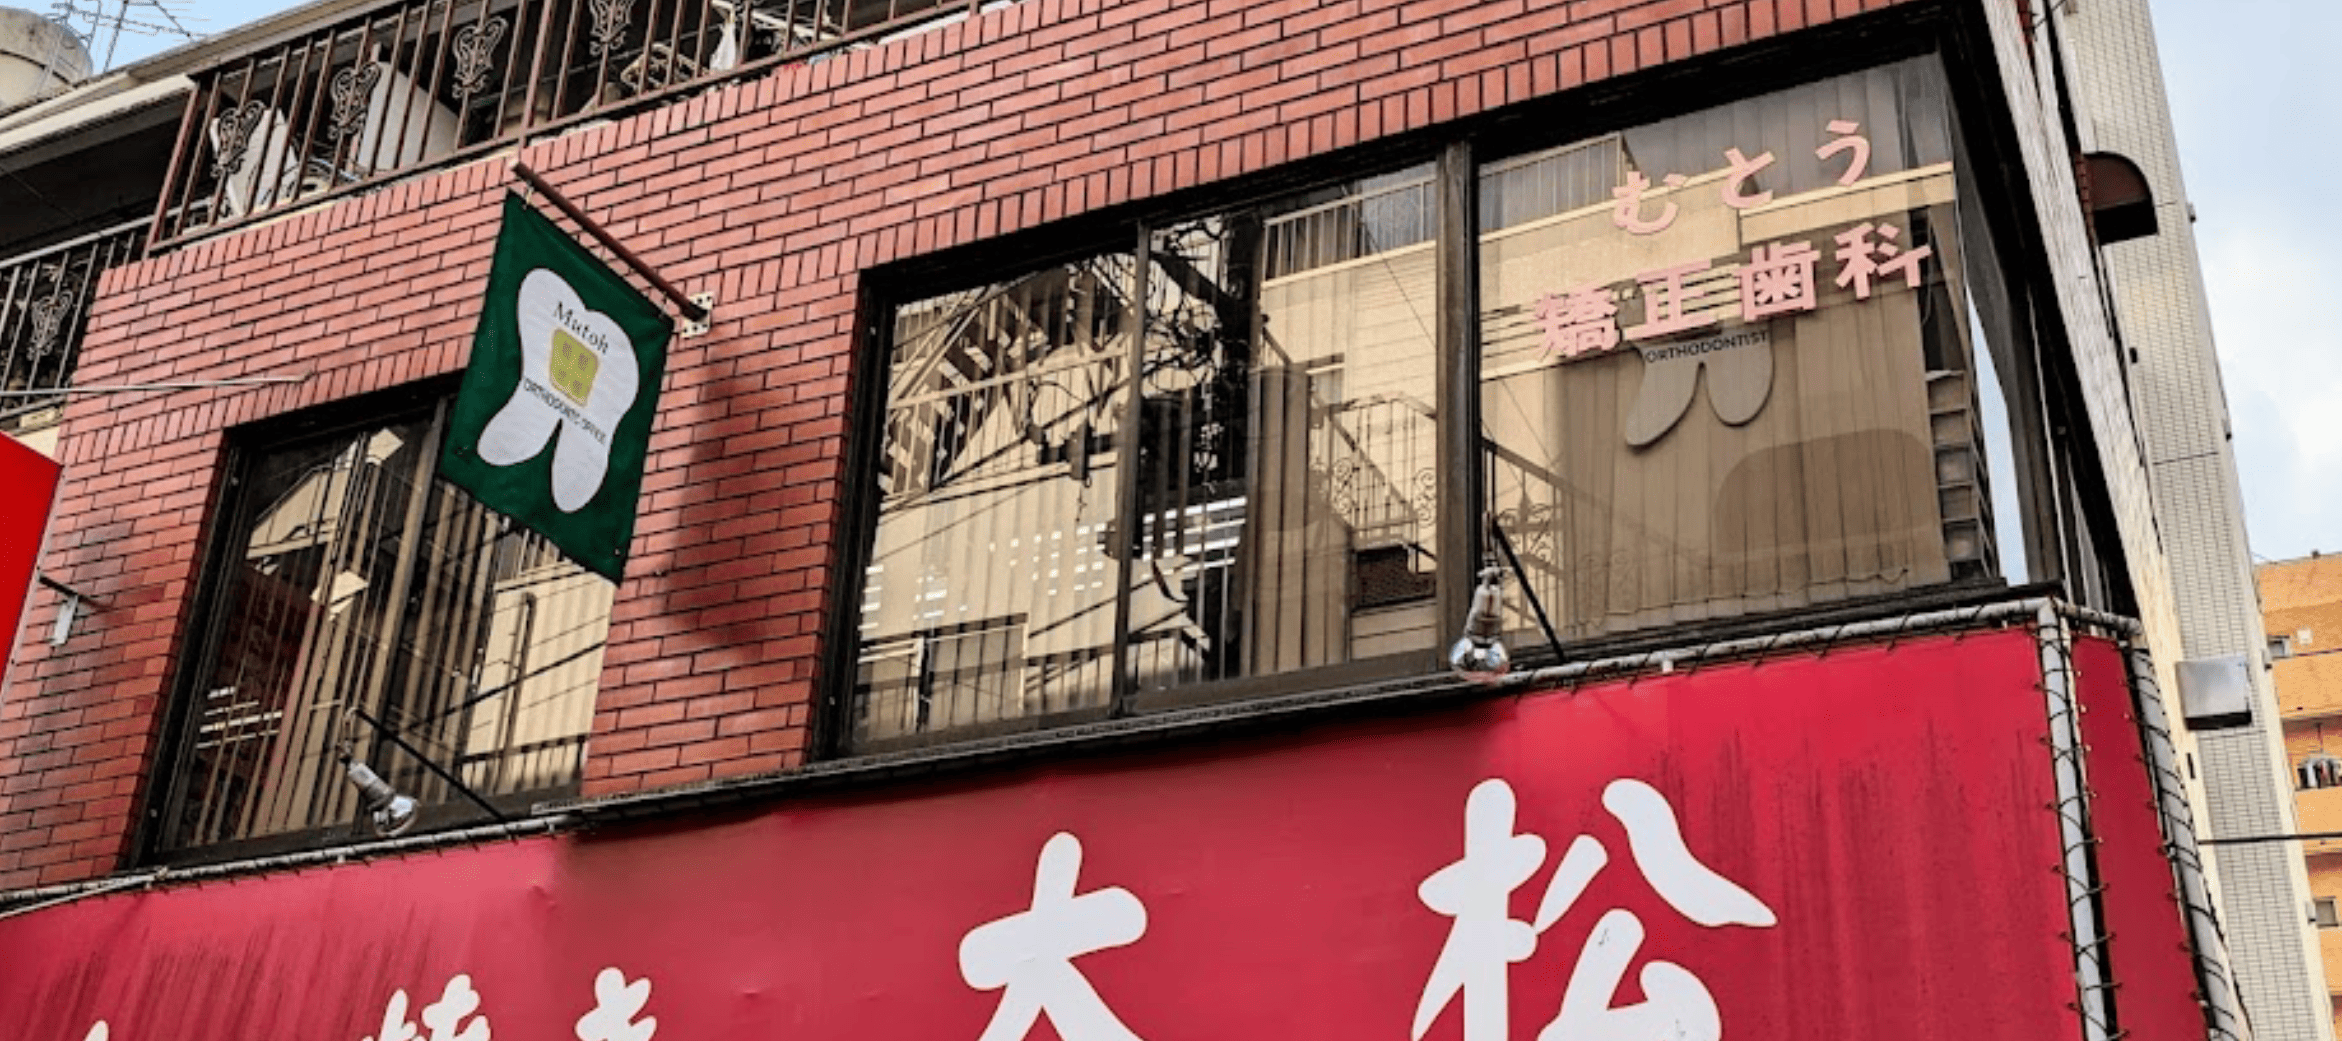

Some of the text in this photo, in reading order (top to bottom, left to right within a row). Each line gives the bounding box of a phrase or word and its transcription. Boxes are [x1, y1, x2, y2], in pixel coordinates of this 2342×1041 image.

[1612, 120, 1870, 235] むとう
[553, 301, 608, 354] Mutoh
[1536, 221, 1932, 358] 矯正歯科
[1645, 331, 1767, 362] ORTHODONTIST
